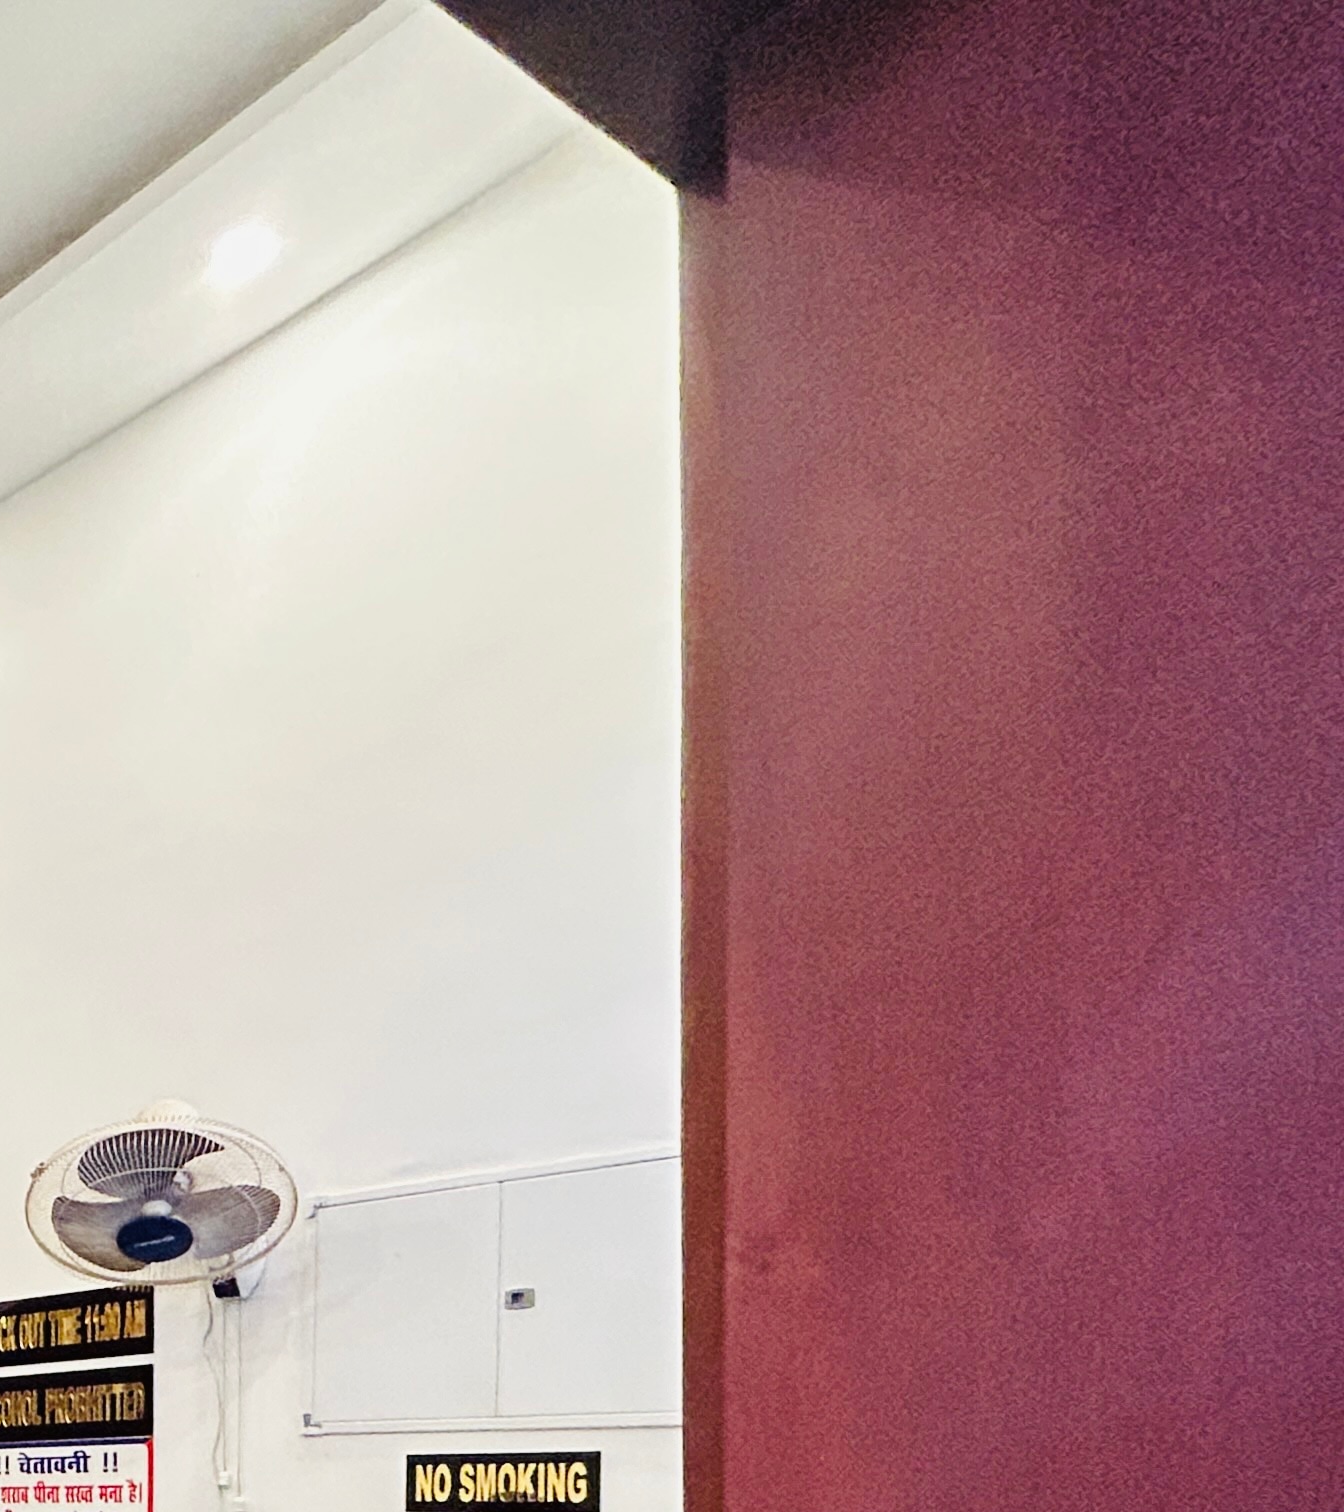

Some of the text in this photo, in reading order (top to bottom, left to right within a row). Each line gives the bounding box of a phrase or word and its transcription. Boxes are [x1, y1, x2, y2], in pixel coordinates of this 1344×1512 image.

[19, 1311, 47, 1350] OUT
[17, 1450, 91, 1474] चेतावनी
[0, 1485, 29, 1504] शराब
[33, 1480, 60, 1503] पीना
[98, 1484, 123, 1503] मना
[415, 1461, 588, 1504] NO SMOKING
